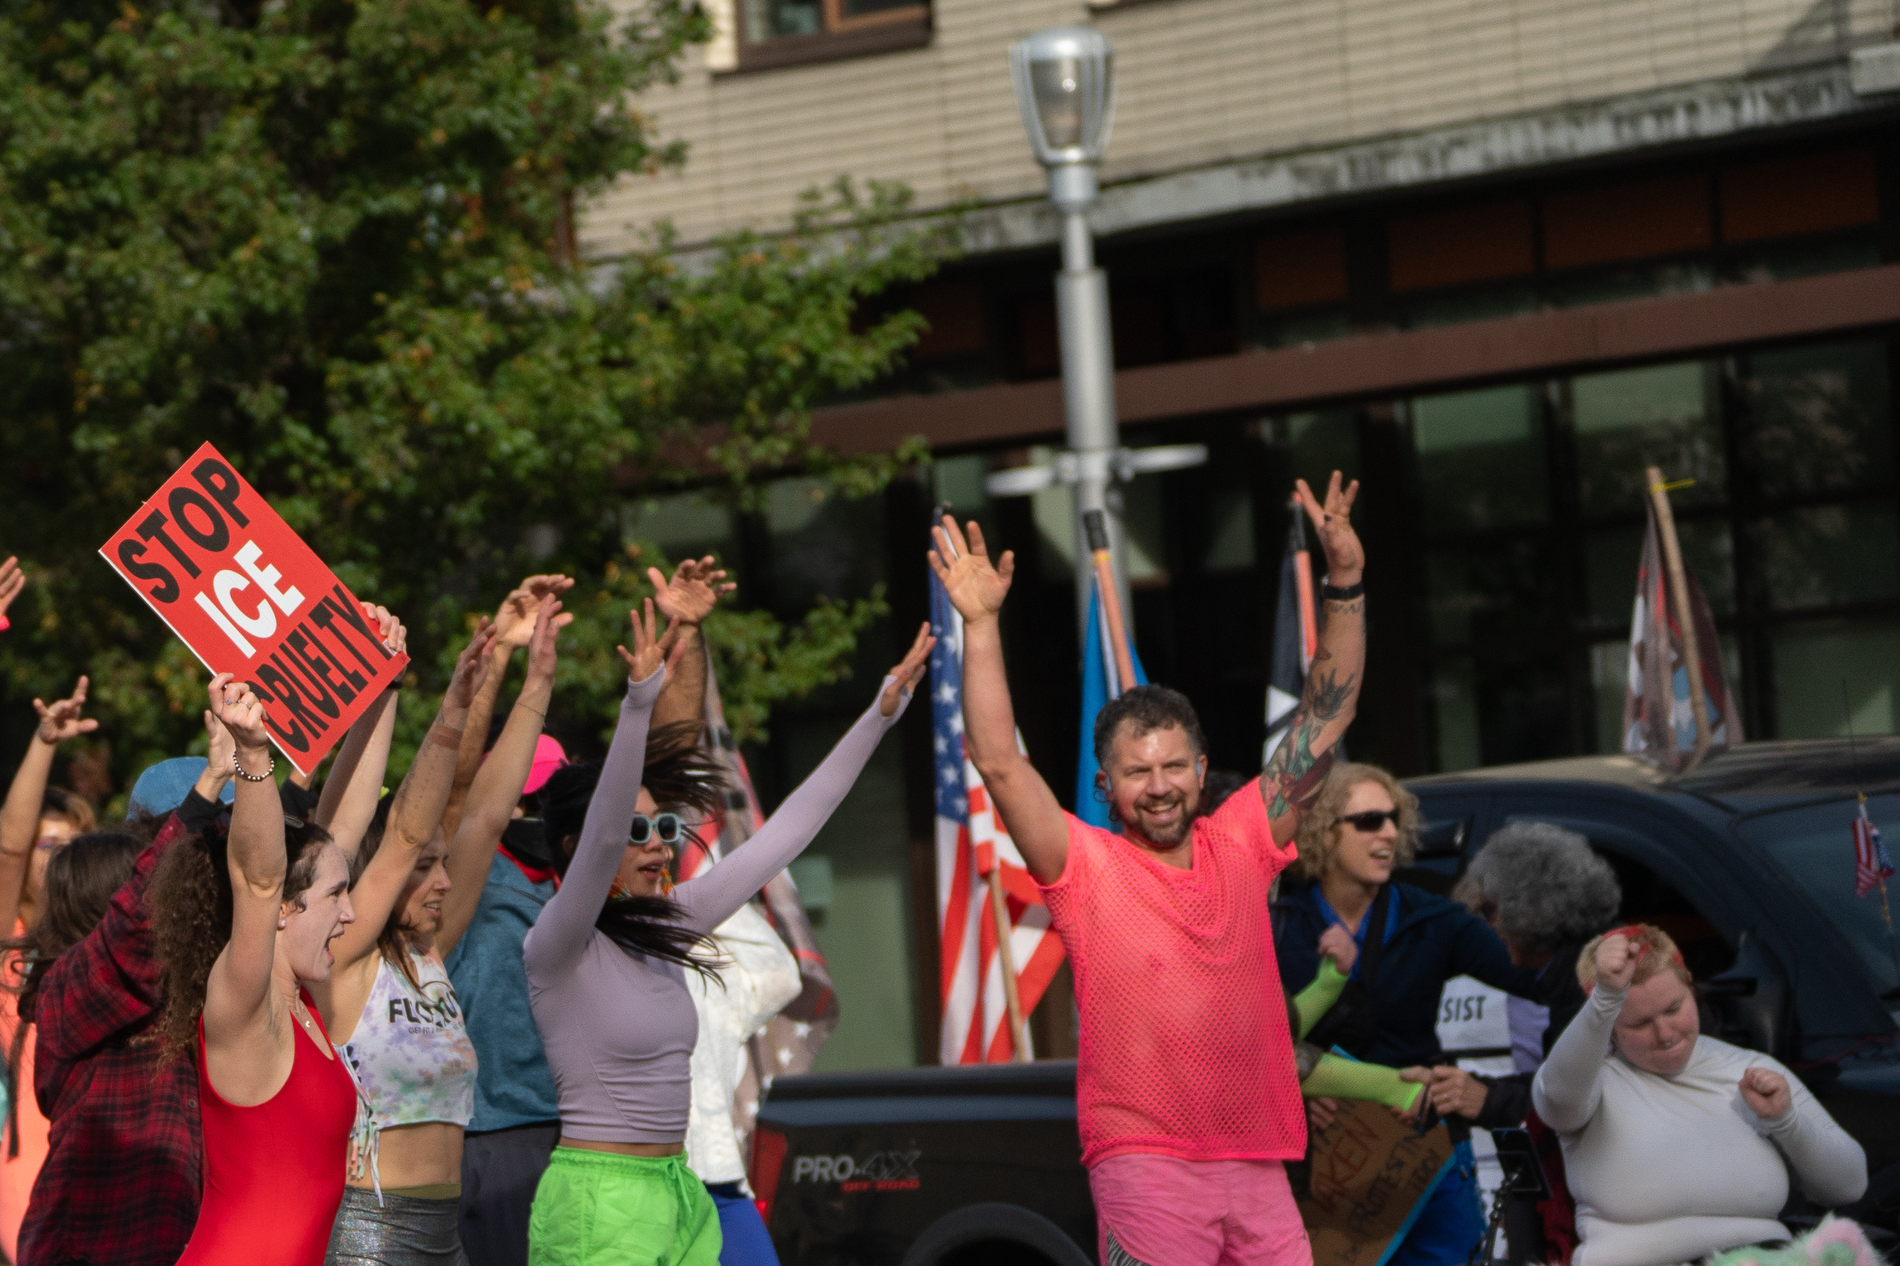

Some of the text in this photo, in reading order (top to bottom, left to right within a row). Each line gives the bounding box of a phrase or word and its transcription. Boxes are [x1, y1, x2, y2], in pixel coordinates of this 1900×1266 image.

[118, 458, 250, 604] STOP
[194, 539, 306, 659] ICE
[246, 584, 393, 753] CRUELTY
[1347, 1133, 1420, 1235] PROTESTIN
